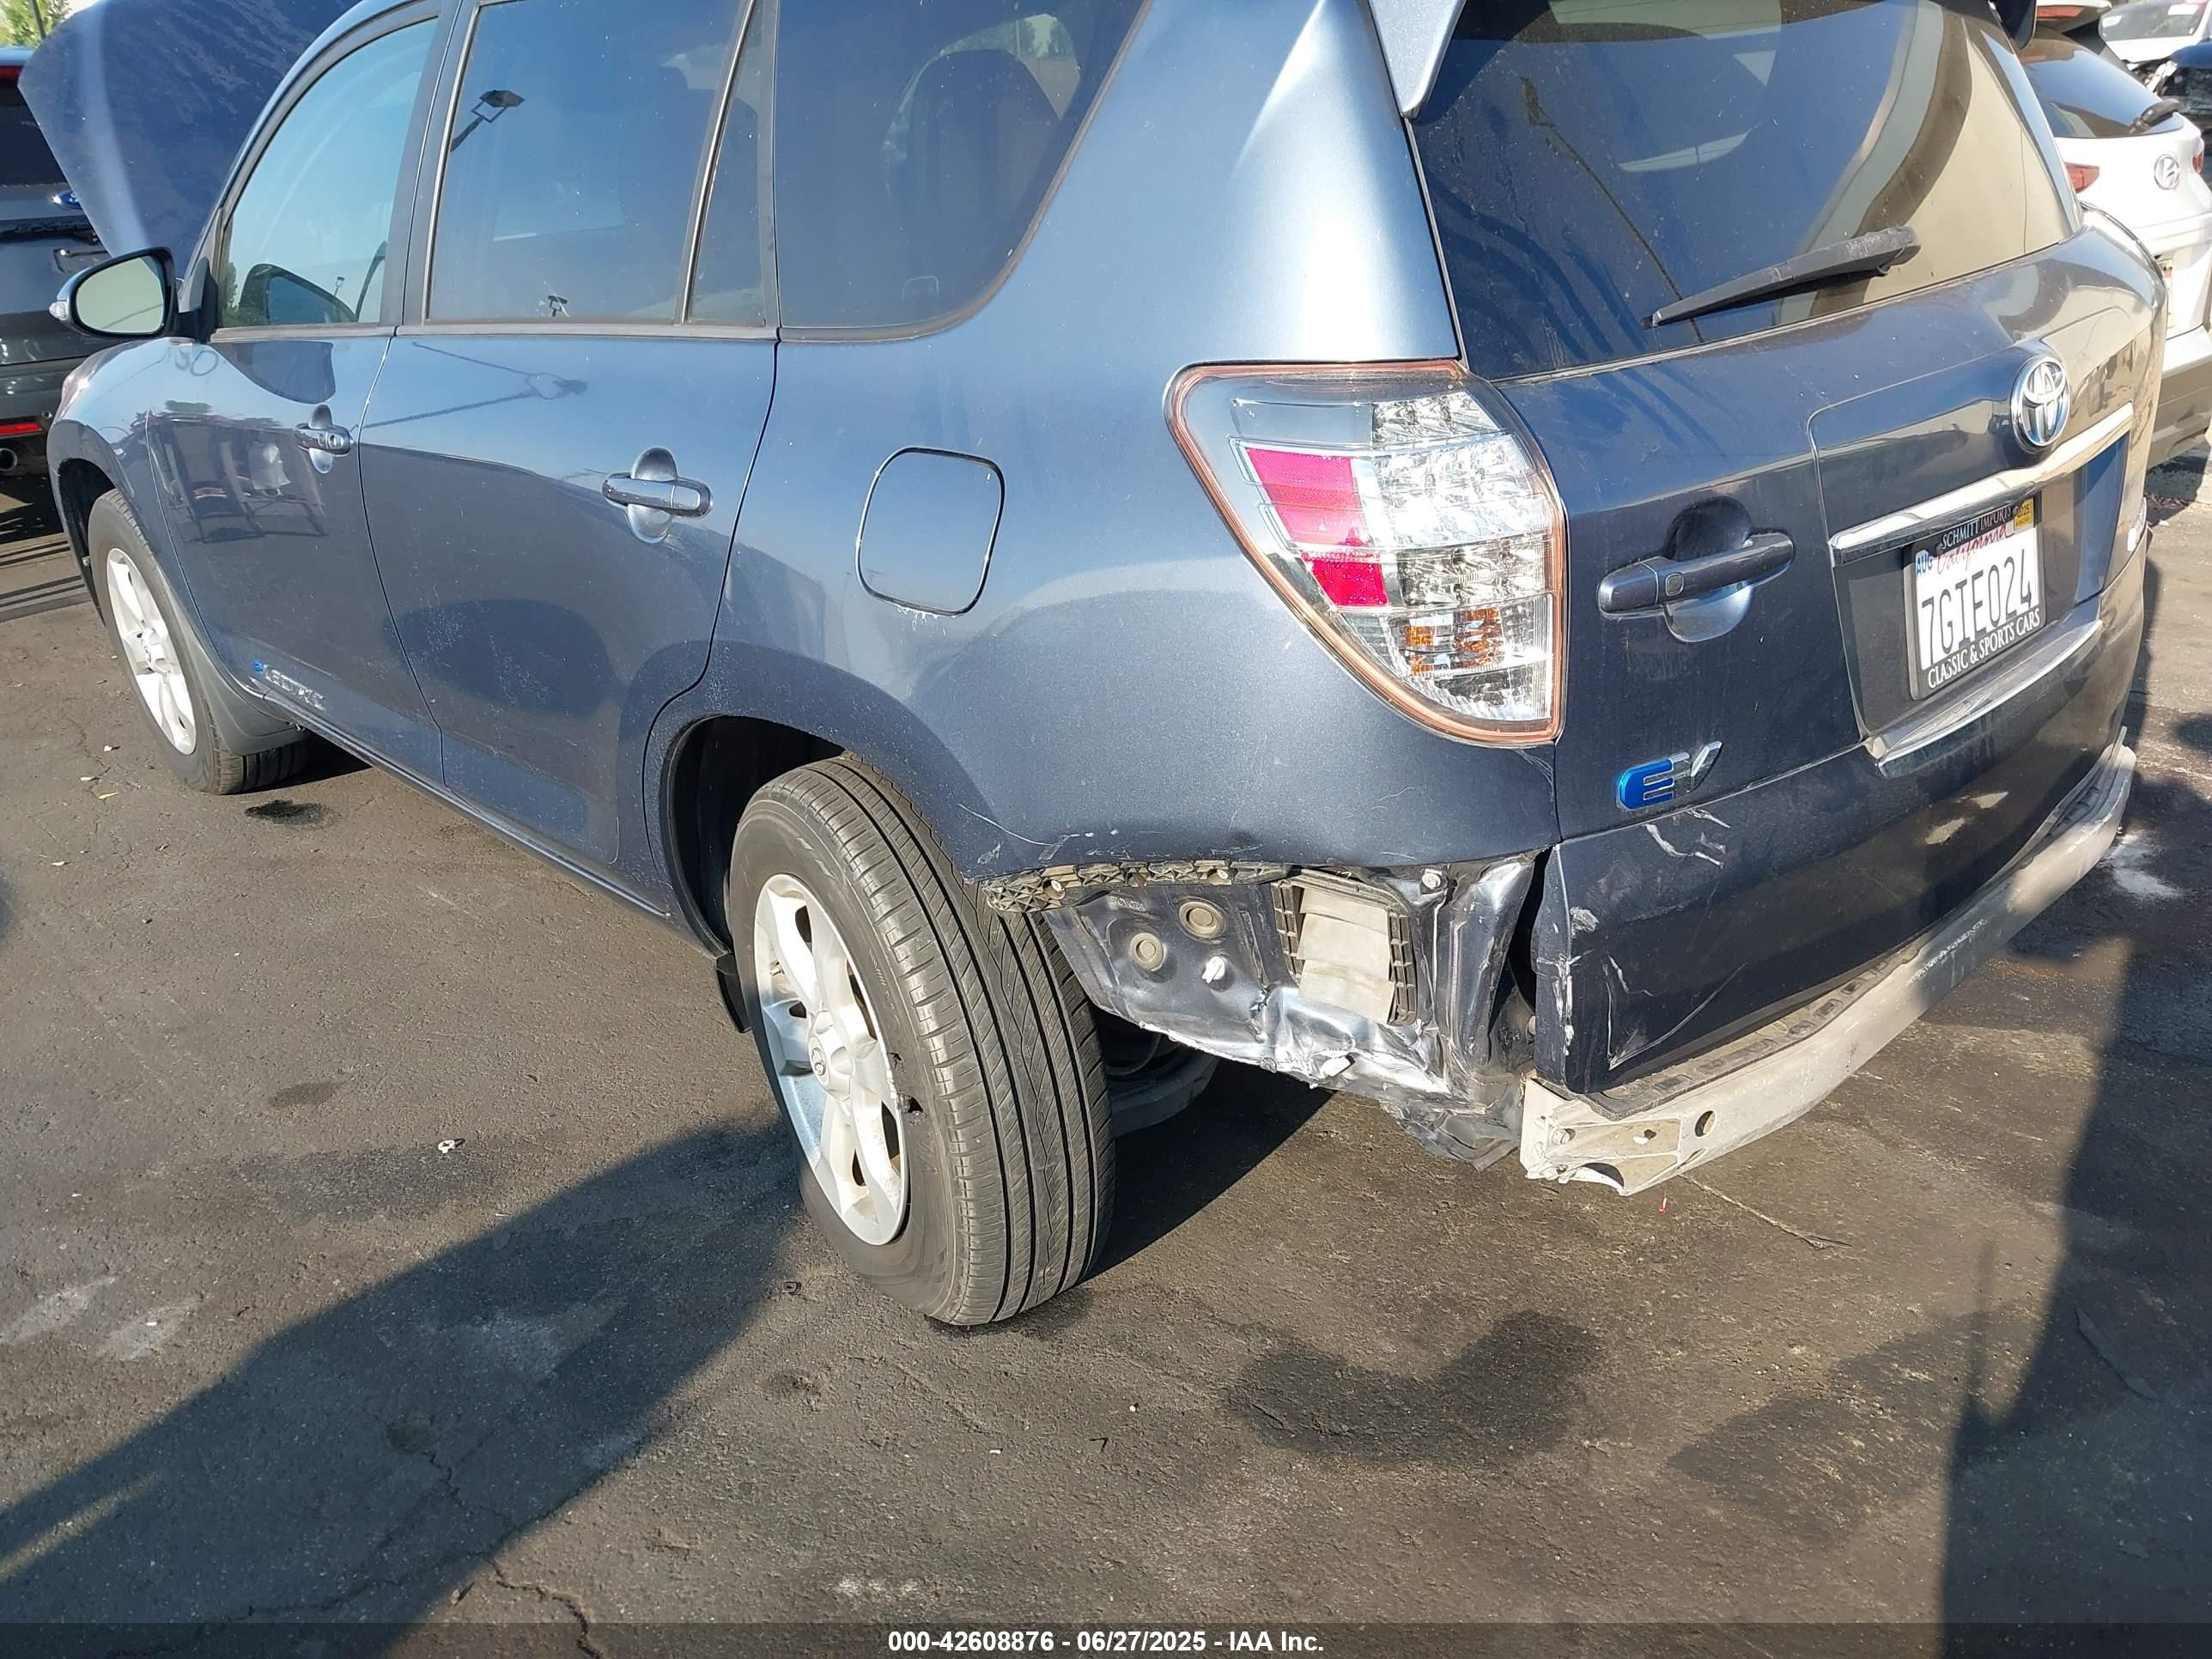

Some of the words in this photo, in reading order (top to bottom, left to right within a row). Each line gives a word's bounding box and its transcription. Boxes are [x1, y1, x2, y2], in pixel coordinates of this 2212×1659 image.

[1942, 519, 1980, 550] SCHMITT
[1980, 506, 2012, 532] IMPORTS
[1916, 550, 1934, 577] AUG
[1928, 648, 1969, 690] CLASSIC
[1969, 643, 1979, 665] &
[1978, 622, 2015, 661] SPORTS
[2016, 608, 2040, 638] CARS
